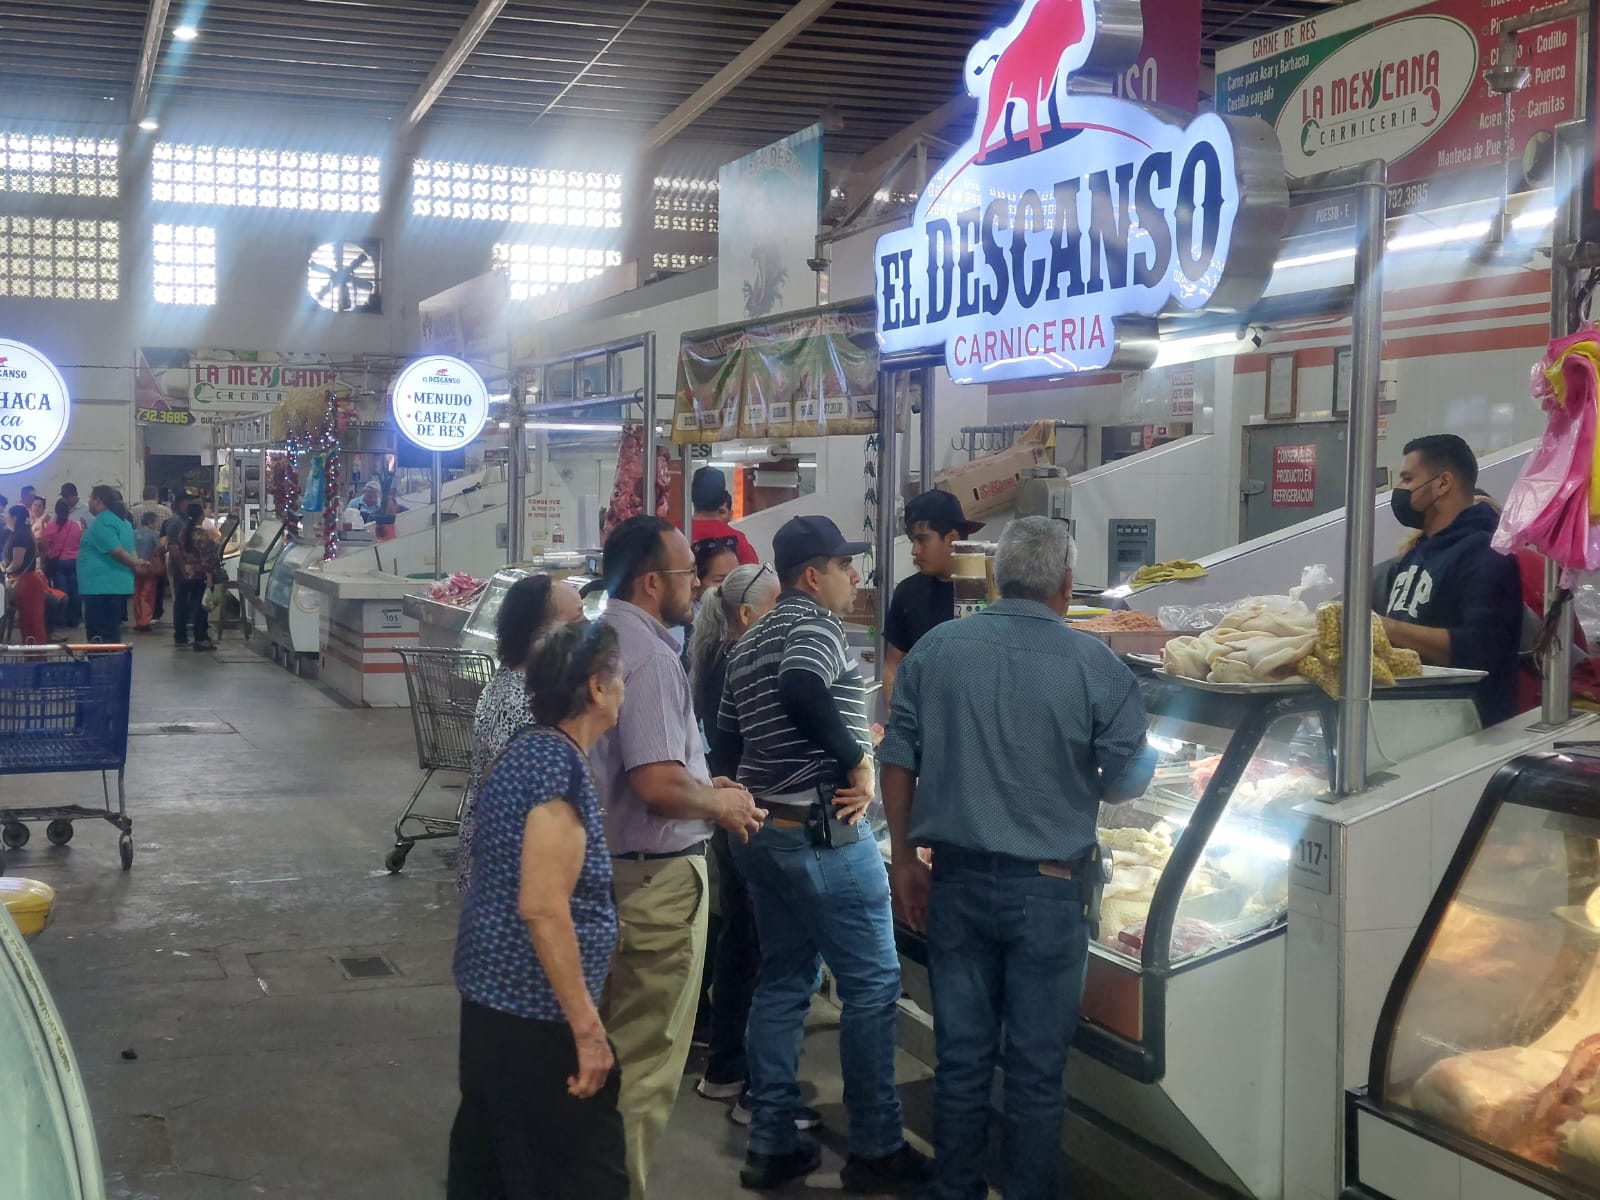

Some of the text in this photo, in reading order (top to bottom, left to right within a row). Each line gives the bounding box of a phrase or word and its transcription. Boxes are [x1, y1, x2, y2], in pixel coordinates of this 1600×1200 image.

[1252, 19, 1317, 59] CARNE DE RES
[1536, 30, 1568, 53] Codillo
[1227, 53, 1310, 92] Carne para Asar y Barbacoa
[1535, 64, 1566, 85] Puerco
[1302, 85, 1324, 124] LA
[1331, 49, 1440, 116] MEXICANA
[1227, 85, 1275, 113] Costilla cargada
[1527, 96, 1565, 119] Carnitas
[1320, 106, 1418, 146] CARNICERIA
[1438, 138, 1515, 167] Manteca de Pueo
[881, 141, 1225, 331] EL DESCANSO
[954, 314, 1106, 367] CARNICERIA
[195, 364, 219, 384] LA
[414, 392, 472, 407] MENUDO
[415, 411, 467, 424] CABEZA
[416, 424, 465, 438] DE RES
[1276, 468, 1312, 483] PRODUCTO EN
[386, 614, 399, 622] 105
